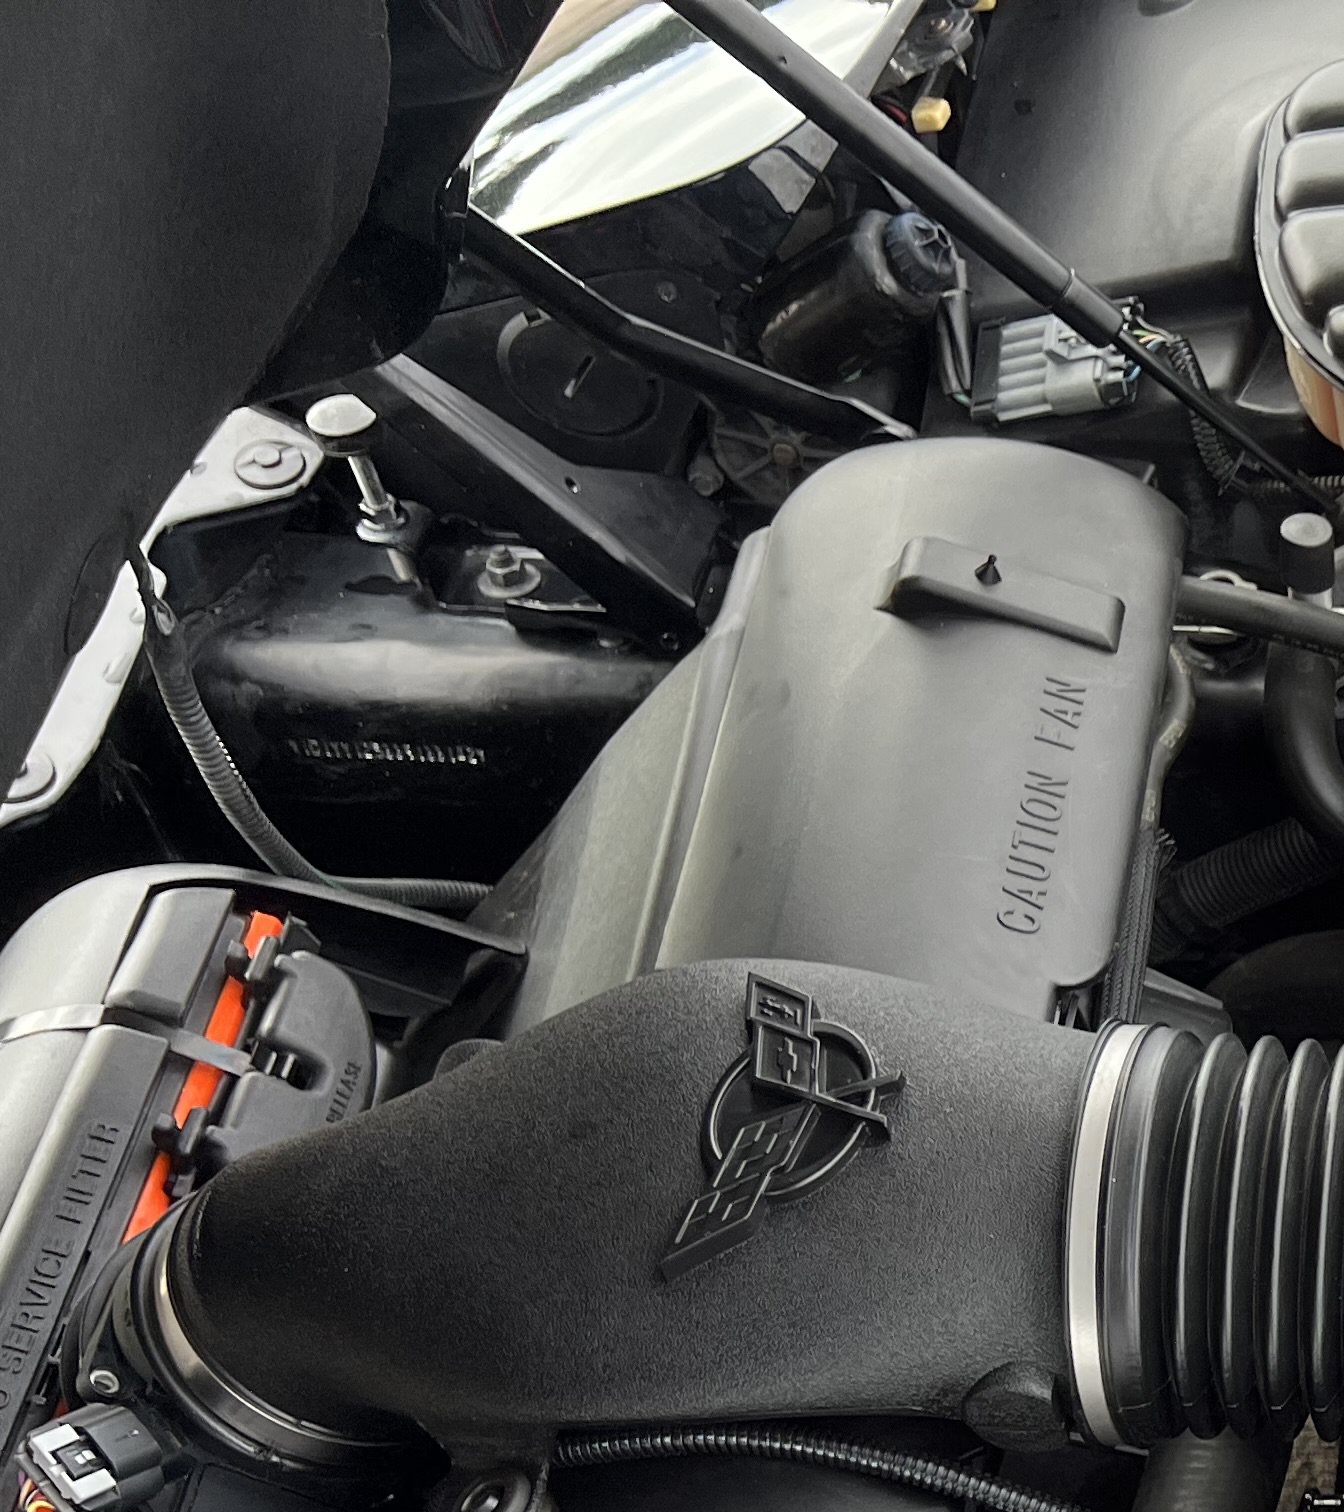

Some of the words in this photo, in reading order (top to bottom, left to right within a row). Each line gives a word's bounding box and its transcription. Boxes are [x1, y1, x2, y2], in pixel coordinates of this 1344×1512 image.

[995, 769, 1070, 937] CAUTION
[1033, 675, 1089, 751] FAN
[0, 1237, 76, 1375] SERVICE
[54, 1121, 120, 1224] FILTER
